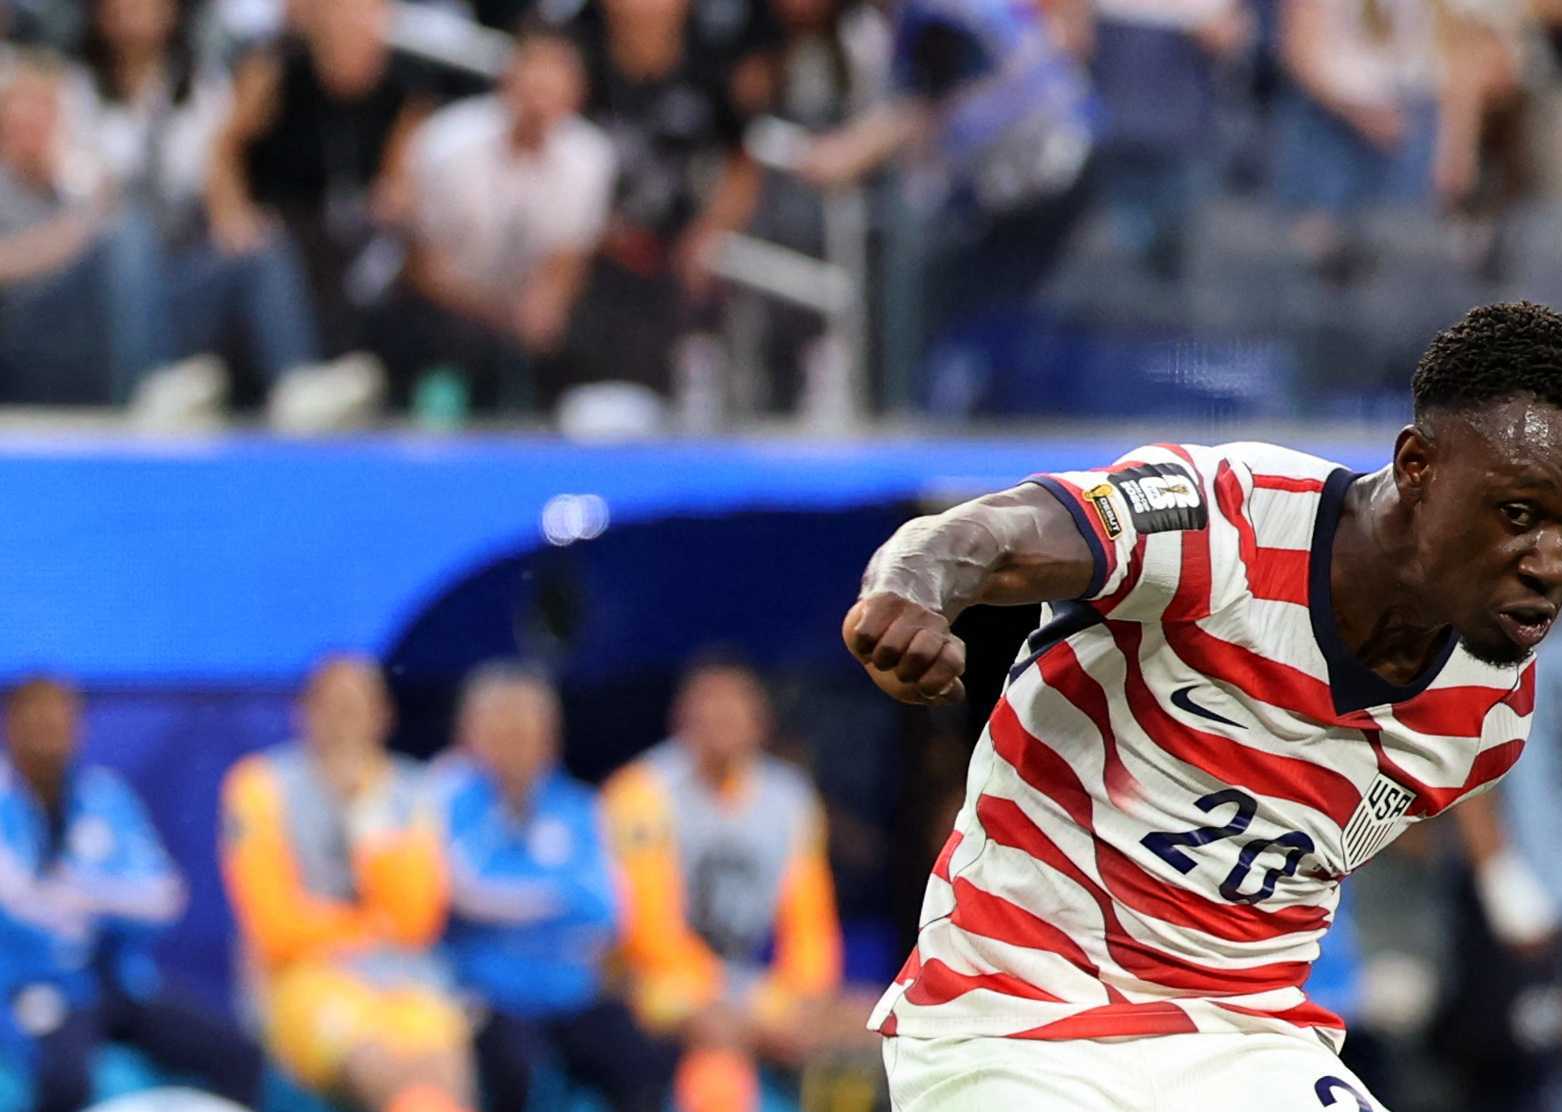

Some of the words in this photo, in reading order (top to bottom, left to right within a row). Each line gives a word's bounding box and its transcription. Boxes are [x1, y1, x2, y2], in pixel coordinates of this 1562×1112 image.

[1099, 496, 1120, 530] DEBUT
[1368, 780, 1412, 821] USA
[1139, 788, 1315, 906] 20
